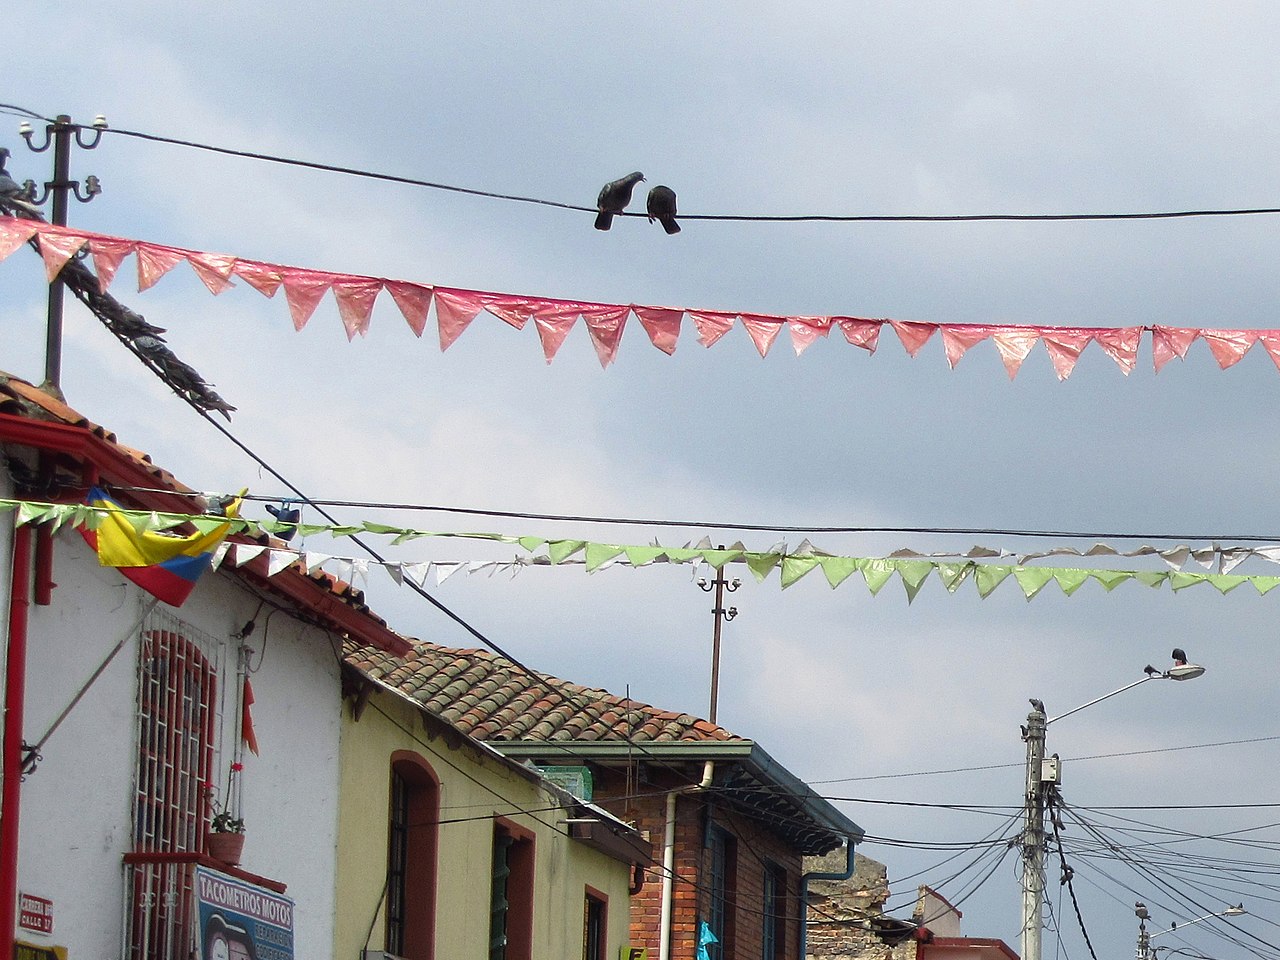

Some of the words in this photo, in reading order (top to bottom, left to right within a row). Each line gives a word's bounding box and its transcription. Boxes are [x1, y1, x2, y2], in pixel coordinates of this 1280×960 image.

[200, 876, 261, 915] TACOMETROS
[262, 902, 291, 926] MOTOS
[21, 915, 42, 927] CALLE
